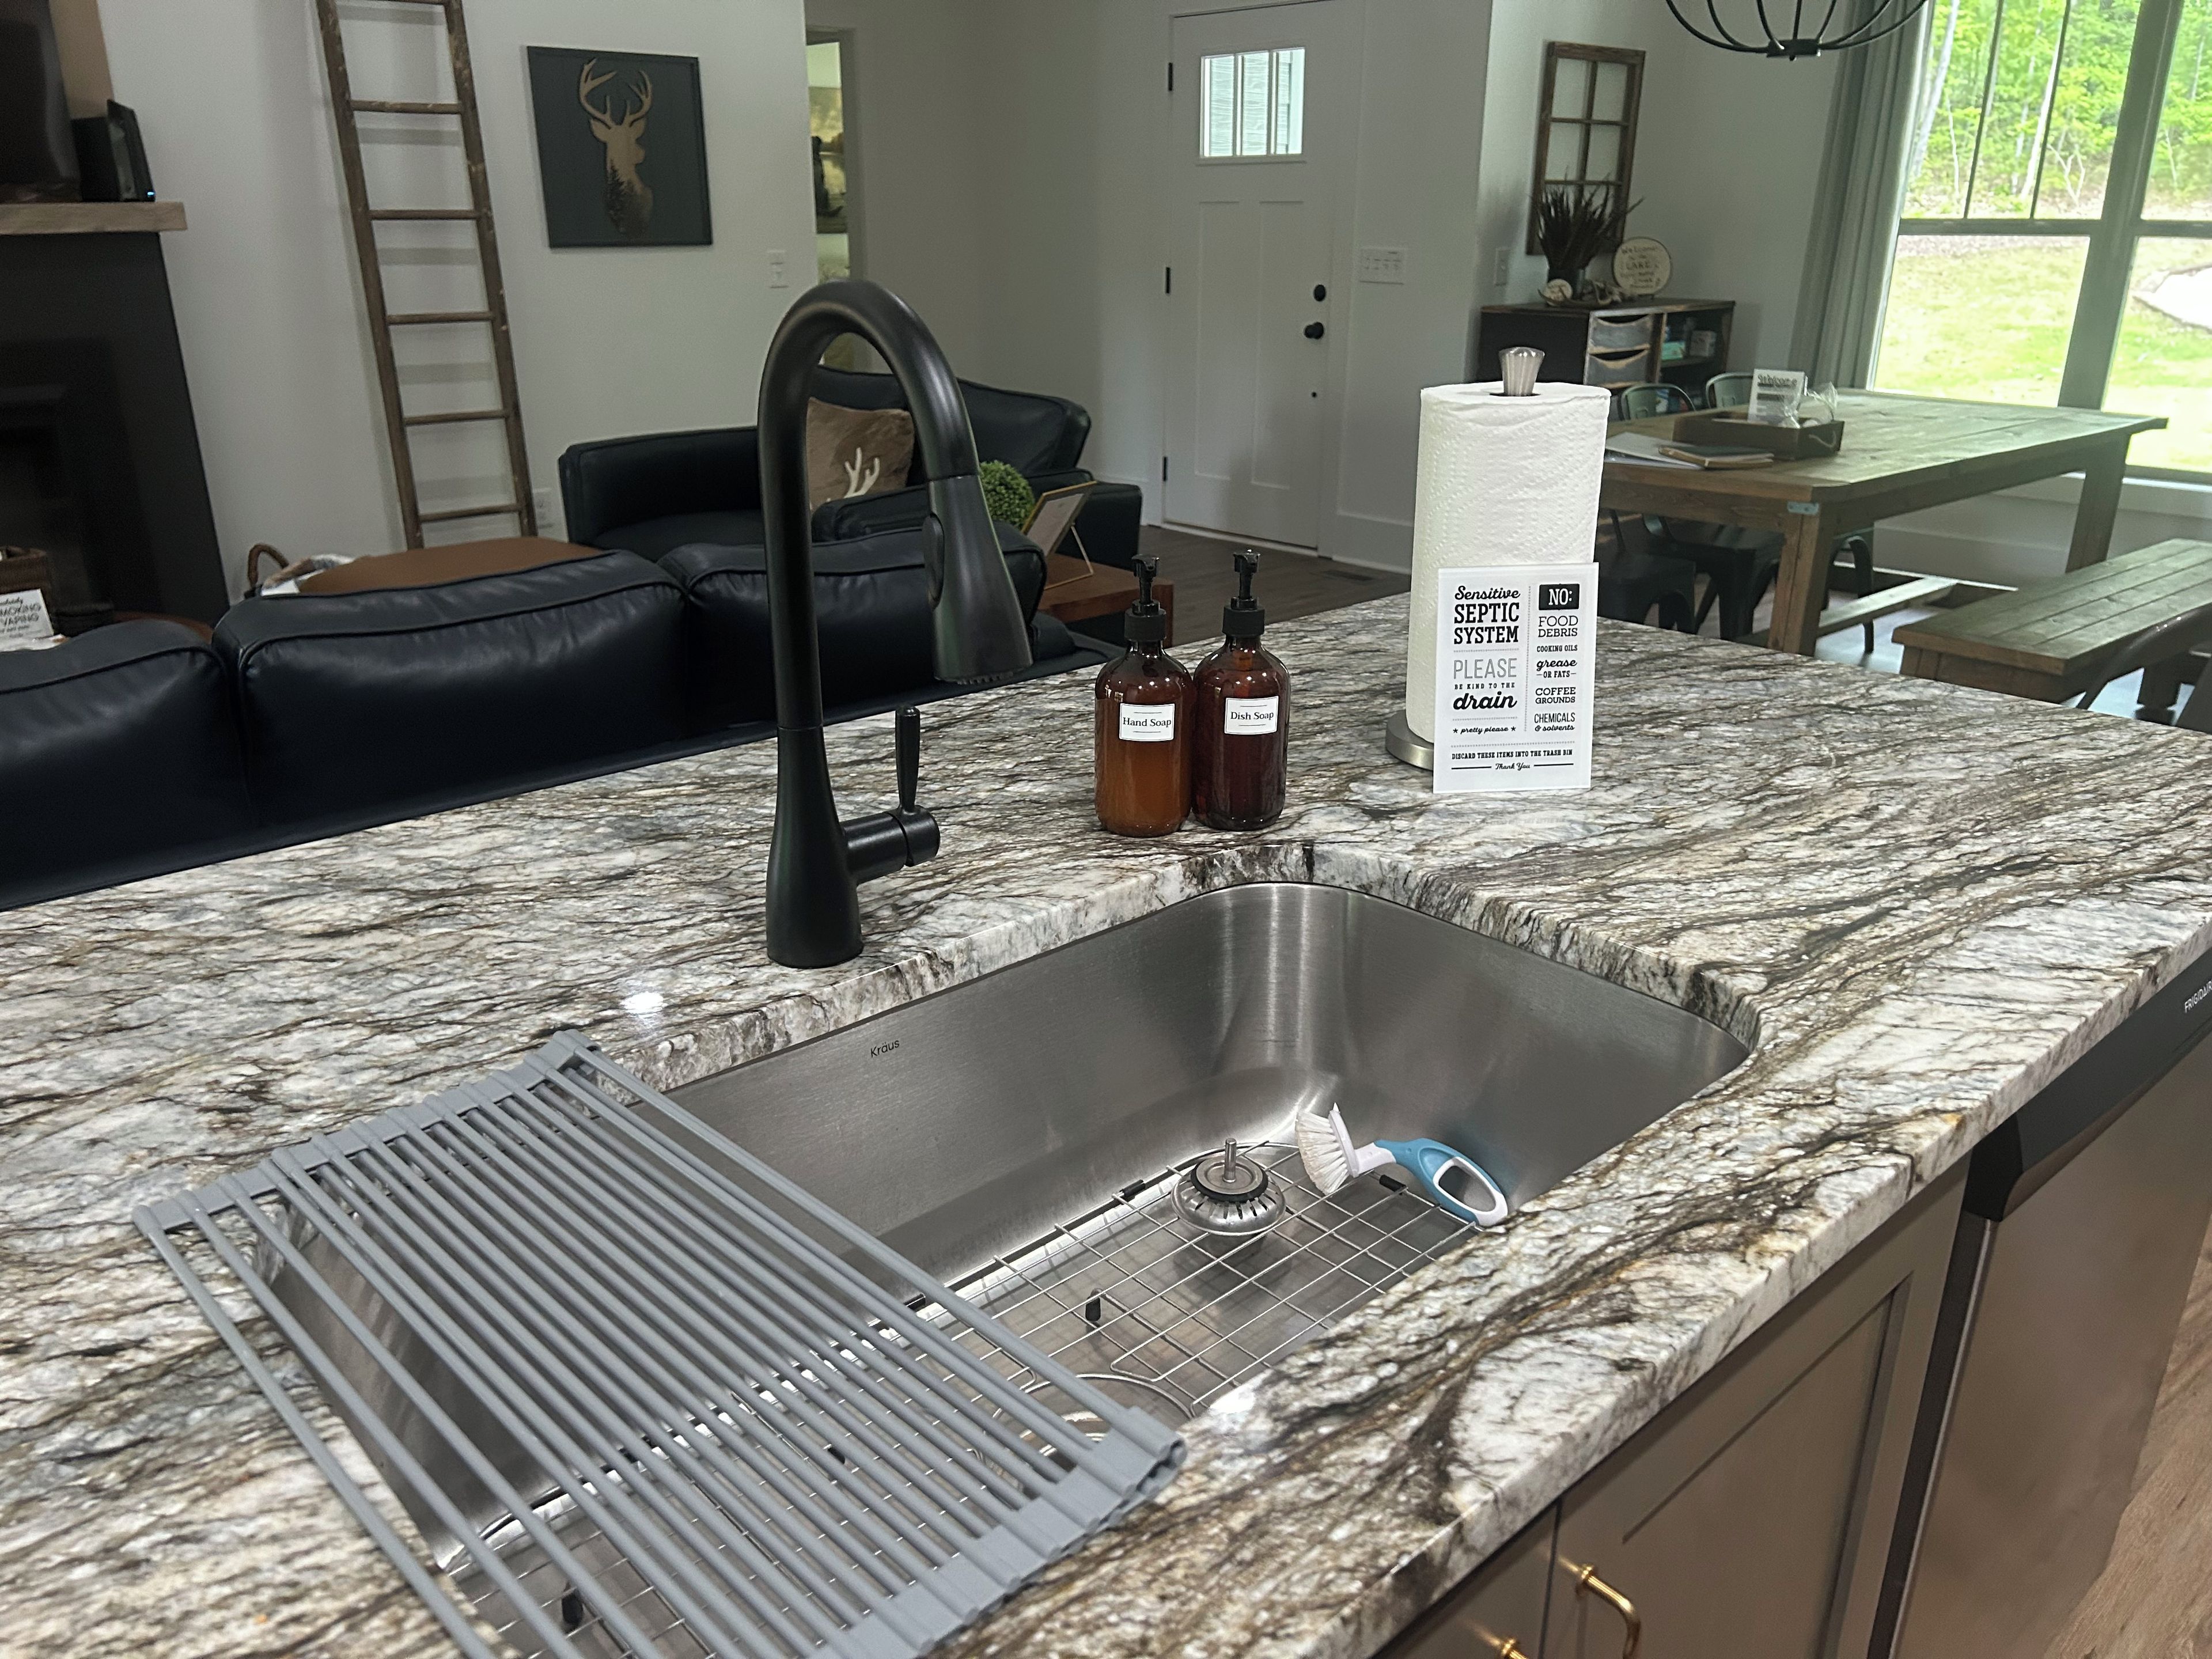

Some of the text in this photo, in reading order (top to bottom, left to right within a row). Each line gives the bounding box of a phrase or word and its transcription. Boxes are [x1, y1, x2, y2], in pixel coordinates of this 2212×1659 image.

[1455, 585, 1521, 600] Sensitive
[1548, 588, 1573, 605] NO:
[1454, 602, 1520, 624] SEPTIC
[1538, 615, 1578, 627] FOOD
[1454, 626, 1519, 645] SYSTEM
[1537, 628, 1578, 638] DEBRIS
[1453, 658, 1517, 679] PLEASE
[1536, 659, 1578, 672] grease
[1535, 687, 1576, 696] COFFEE
[1453, 691, 1517, 710] drain
[1535, 696, 1575, 704] GROUNDS
[1230, 711, 1274, 721] Dish Soap
[1534, 712, 1575, 724] CHEMICALS
[1123, 717, 1172, 728] Hand Soap
[1460, 726, 1509, 734] pretty please
[1516, 762, 1531, 771] You
[2184, 979, 2212, 1013] FRIGIDAIR
